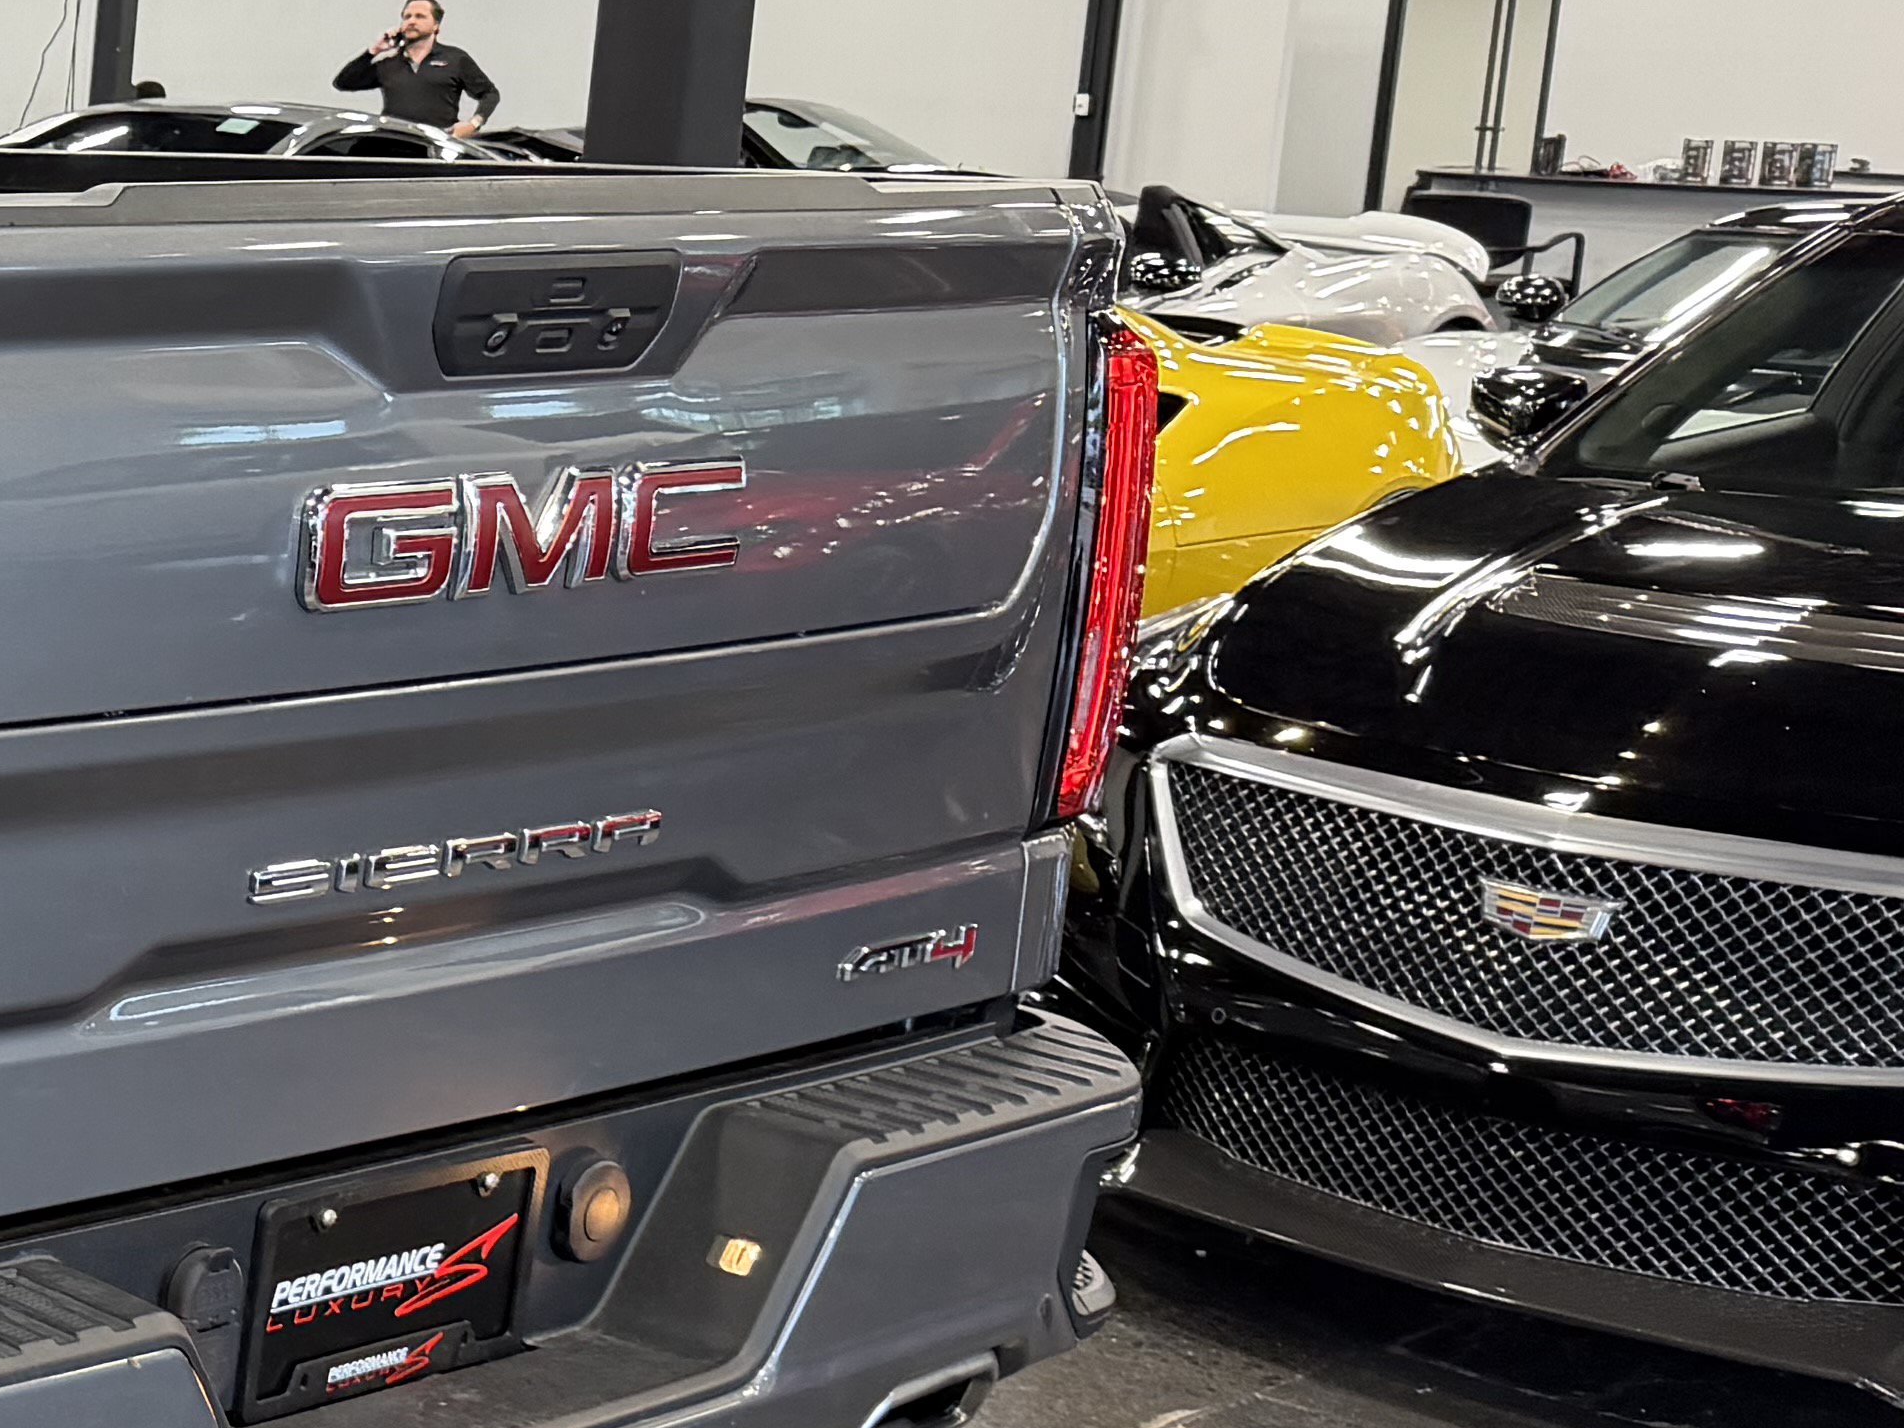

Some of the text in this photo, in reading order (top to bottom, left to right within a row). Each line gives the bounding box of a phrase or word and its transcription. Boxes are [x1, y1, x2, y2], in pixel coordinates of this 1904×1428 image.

[295, 455, 747, 612] GMC
[246, 809, 663, 904] SIERRA
[835, 923, 979, 982] AT4
[265, 1276, 432, 1334] LUXURY
[271, 1242, 446, 1309] PERFORMANCE
[327, 1346, 410, 1383] PERFORMANCE
